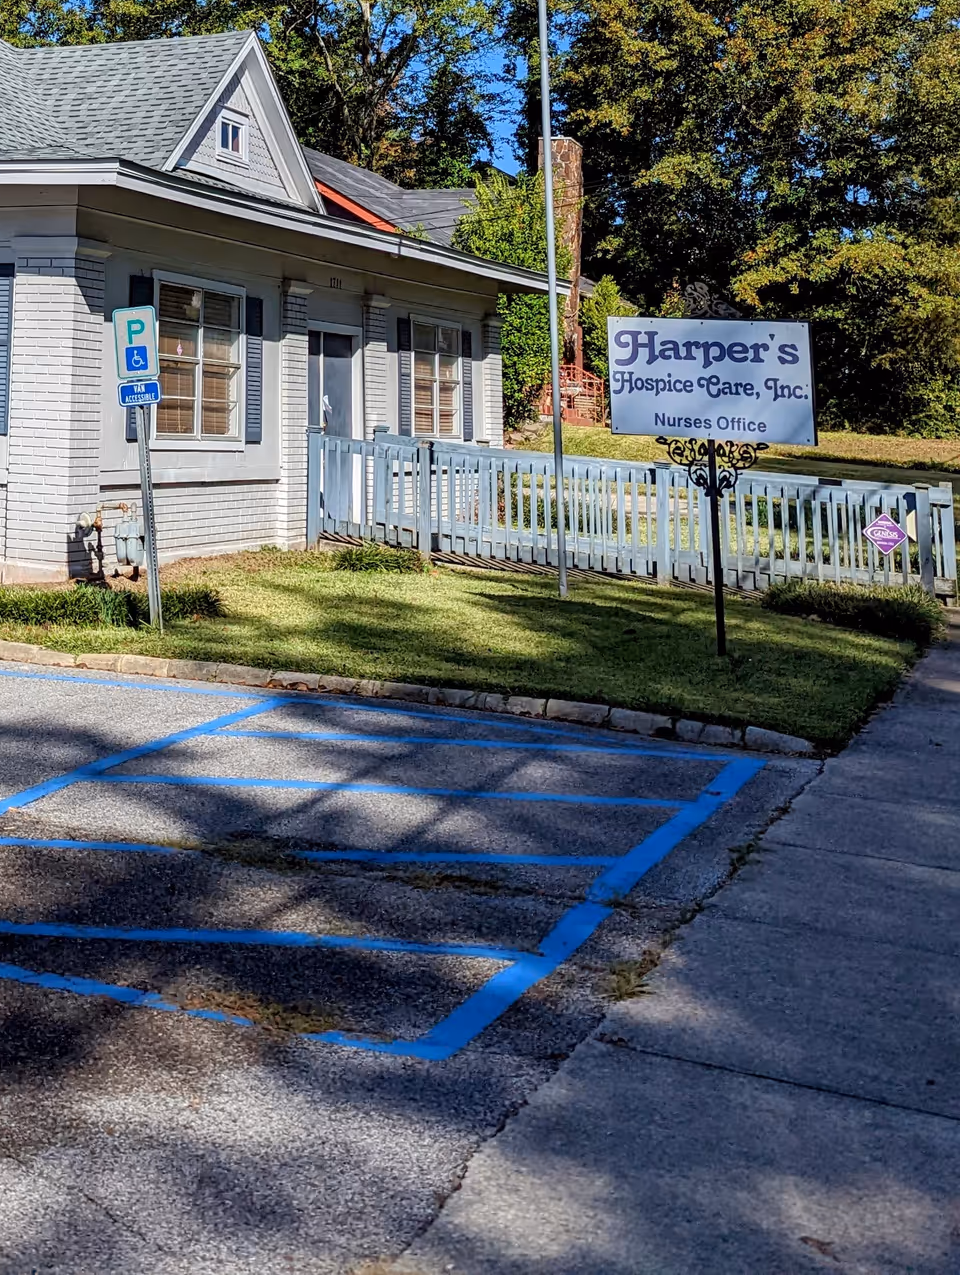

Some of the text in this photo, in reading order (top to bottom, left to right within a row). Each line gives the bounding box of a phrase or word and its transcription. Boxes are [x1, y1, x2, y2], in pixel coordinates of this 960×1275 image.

[126, 318, 145, 345] P
[614, 329, 800, 369] Harper's
[133, 384, 146, 393] VAN
[612, 370, 809, 401] Hospice Care, Inc.
[125, 392, 156, 403] ACCESSIBLE
[654, 412, 767, 433] Nurses Office
[873, 529, 899, 539] GENESIS
